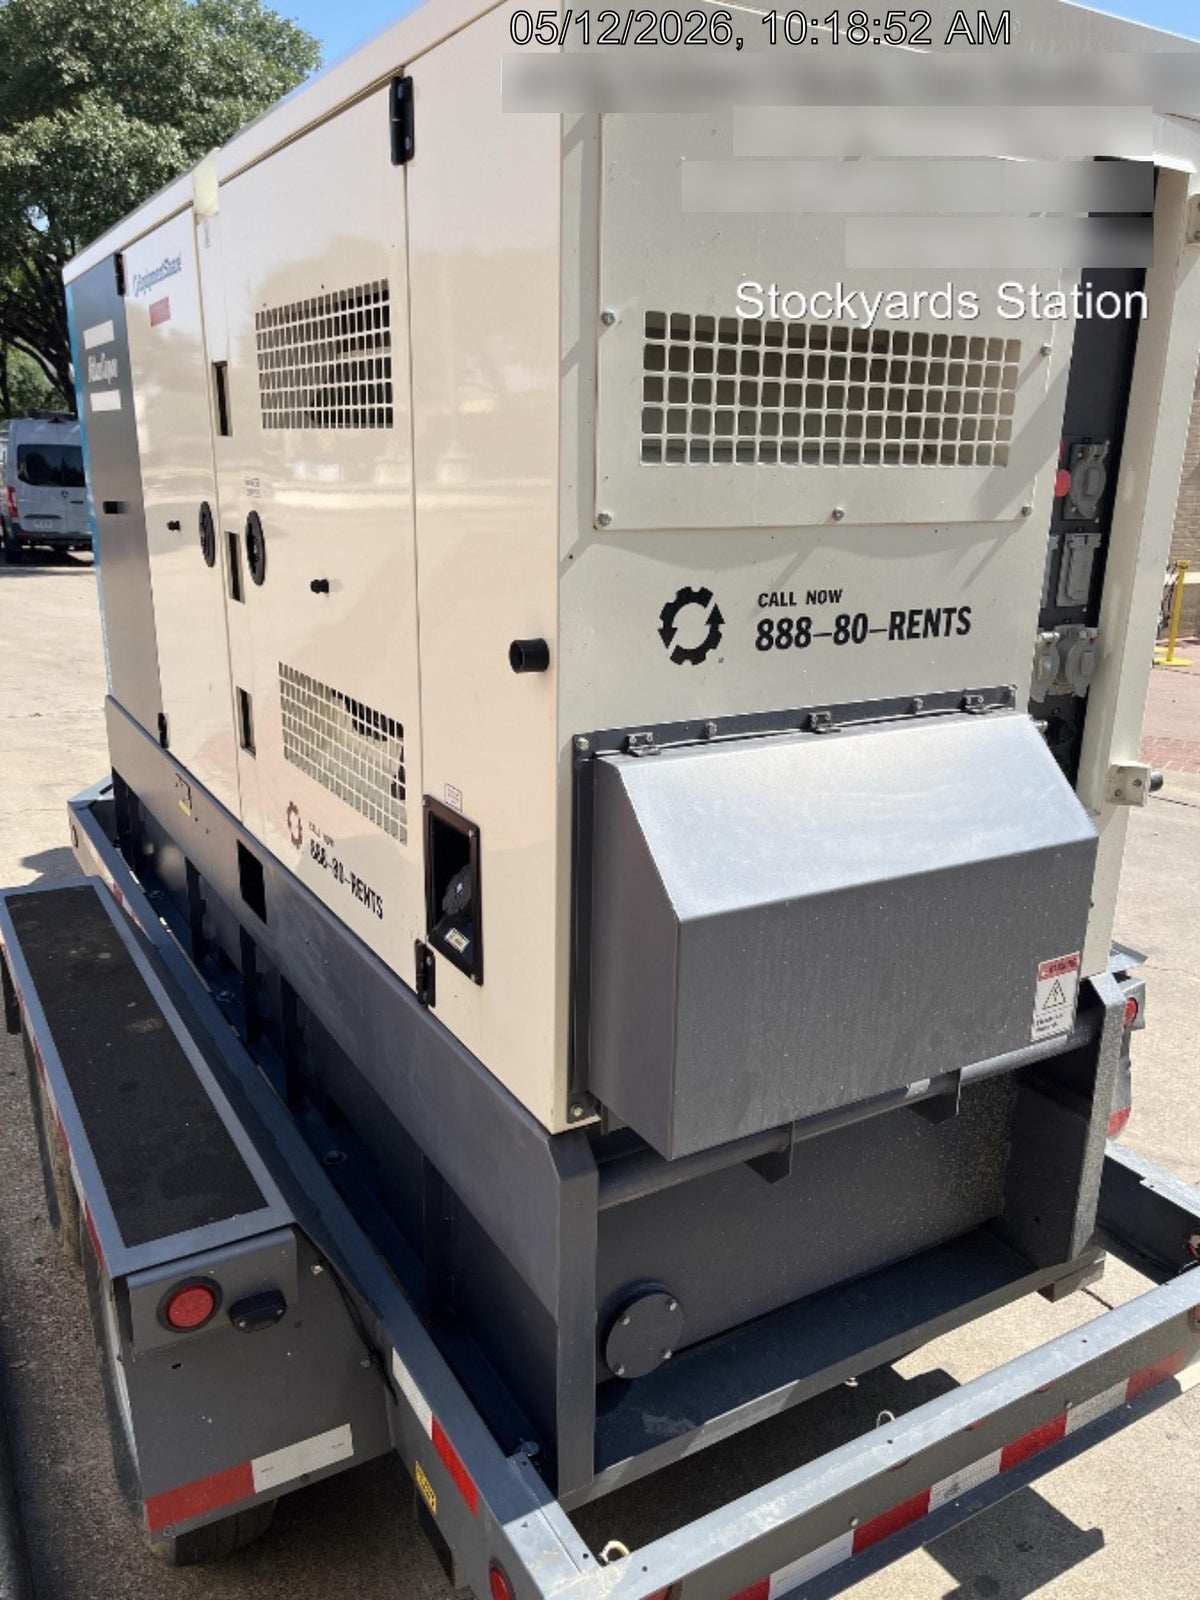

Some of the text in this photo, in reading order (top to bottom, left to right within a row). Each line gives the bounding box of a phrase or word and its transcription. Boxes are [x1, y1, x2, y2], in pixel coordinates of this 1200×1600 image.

[757, 588, 843, 608] CALL NOW
[755, 606, 972, 652] 888-80-RENTS
